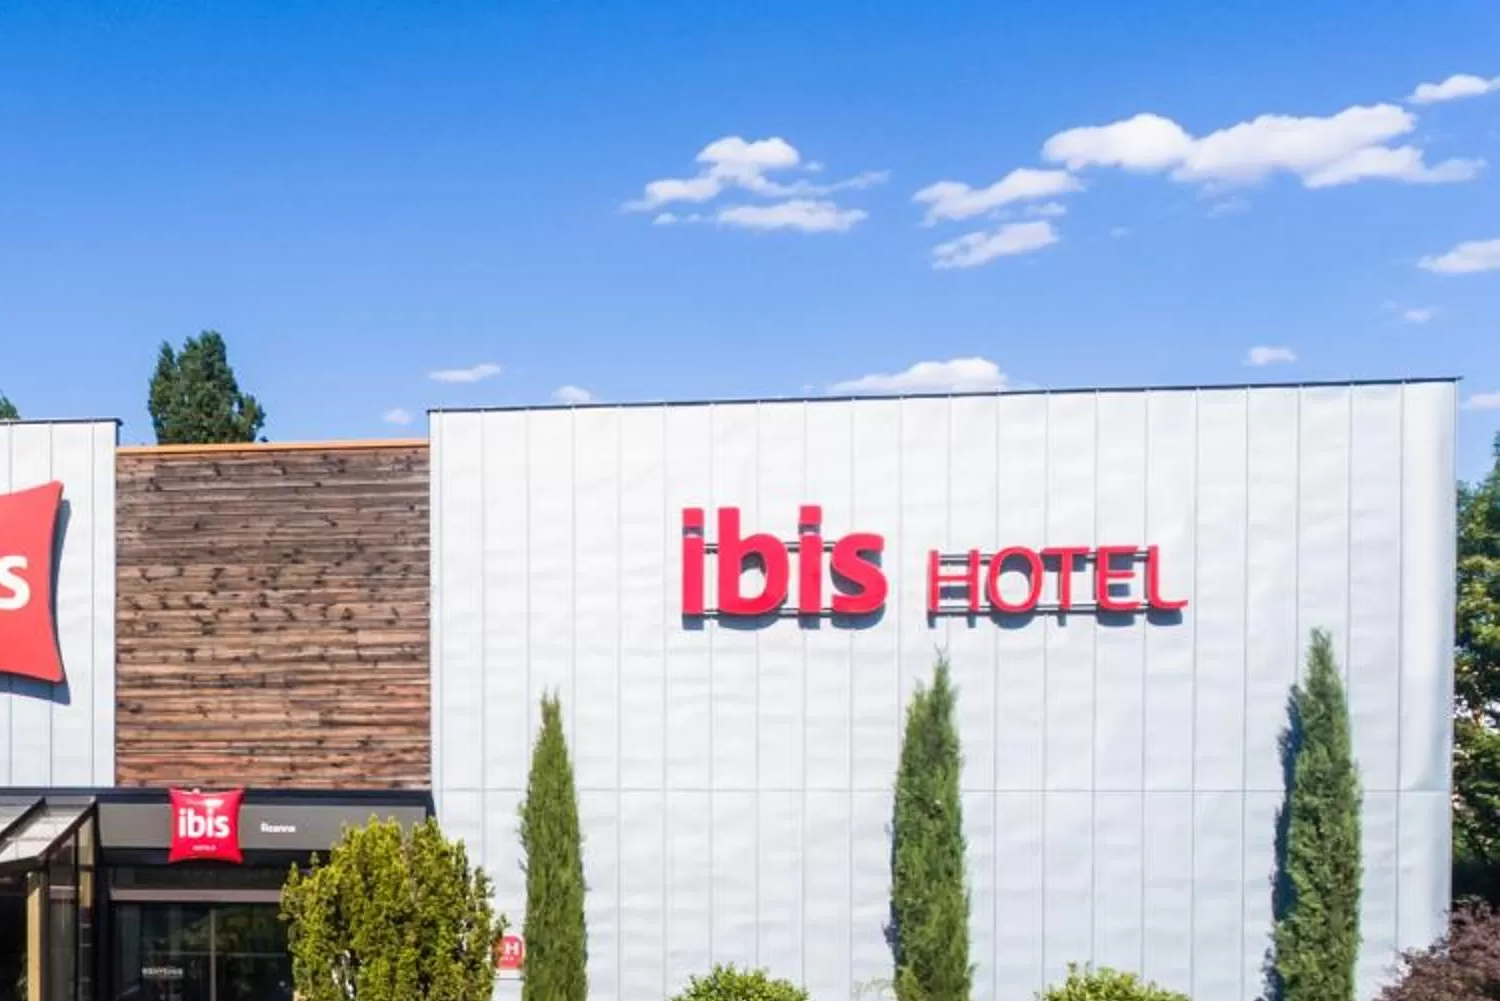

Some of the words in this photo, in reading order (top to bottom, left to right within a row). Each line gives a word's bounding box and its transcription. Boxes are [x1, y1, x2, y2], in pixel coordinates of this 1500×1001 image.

[682, 505, 888, 614] ibis
[927, 546, 1188, 612] HOTEL
[178, 807, 230, 838] ibis
